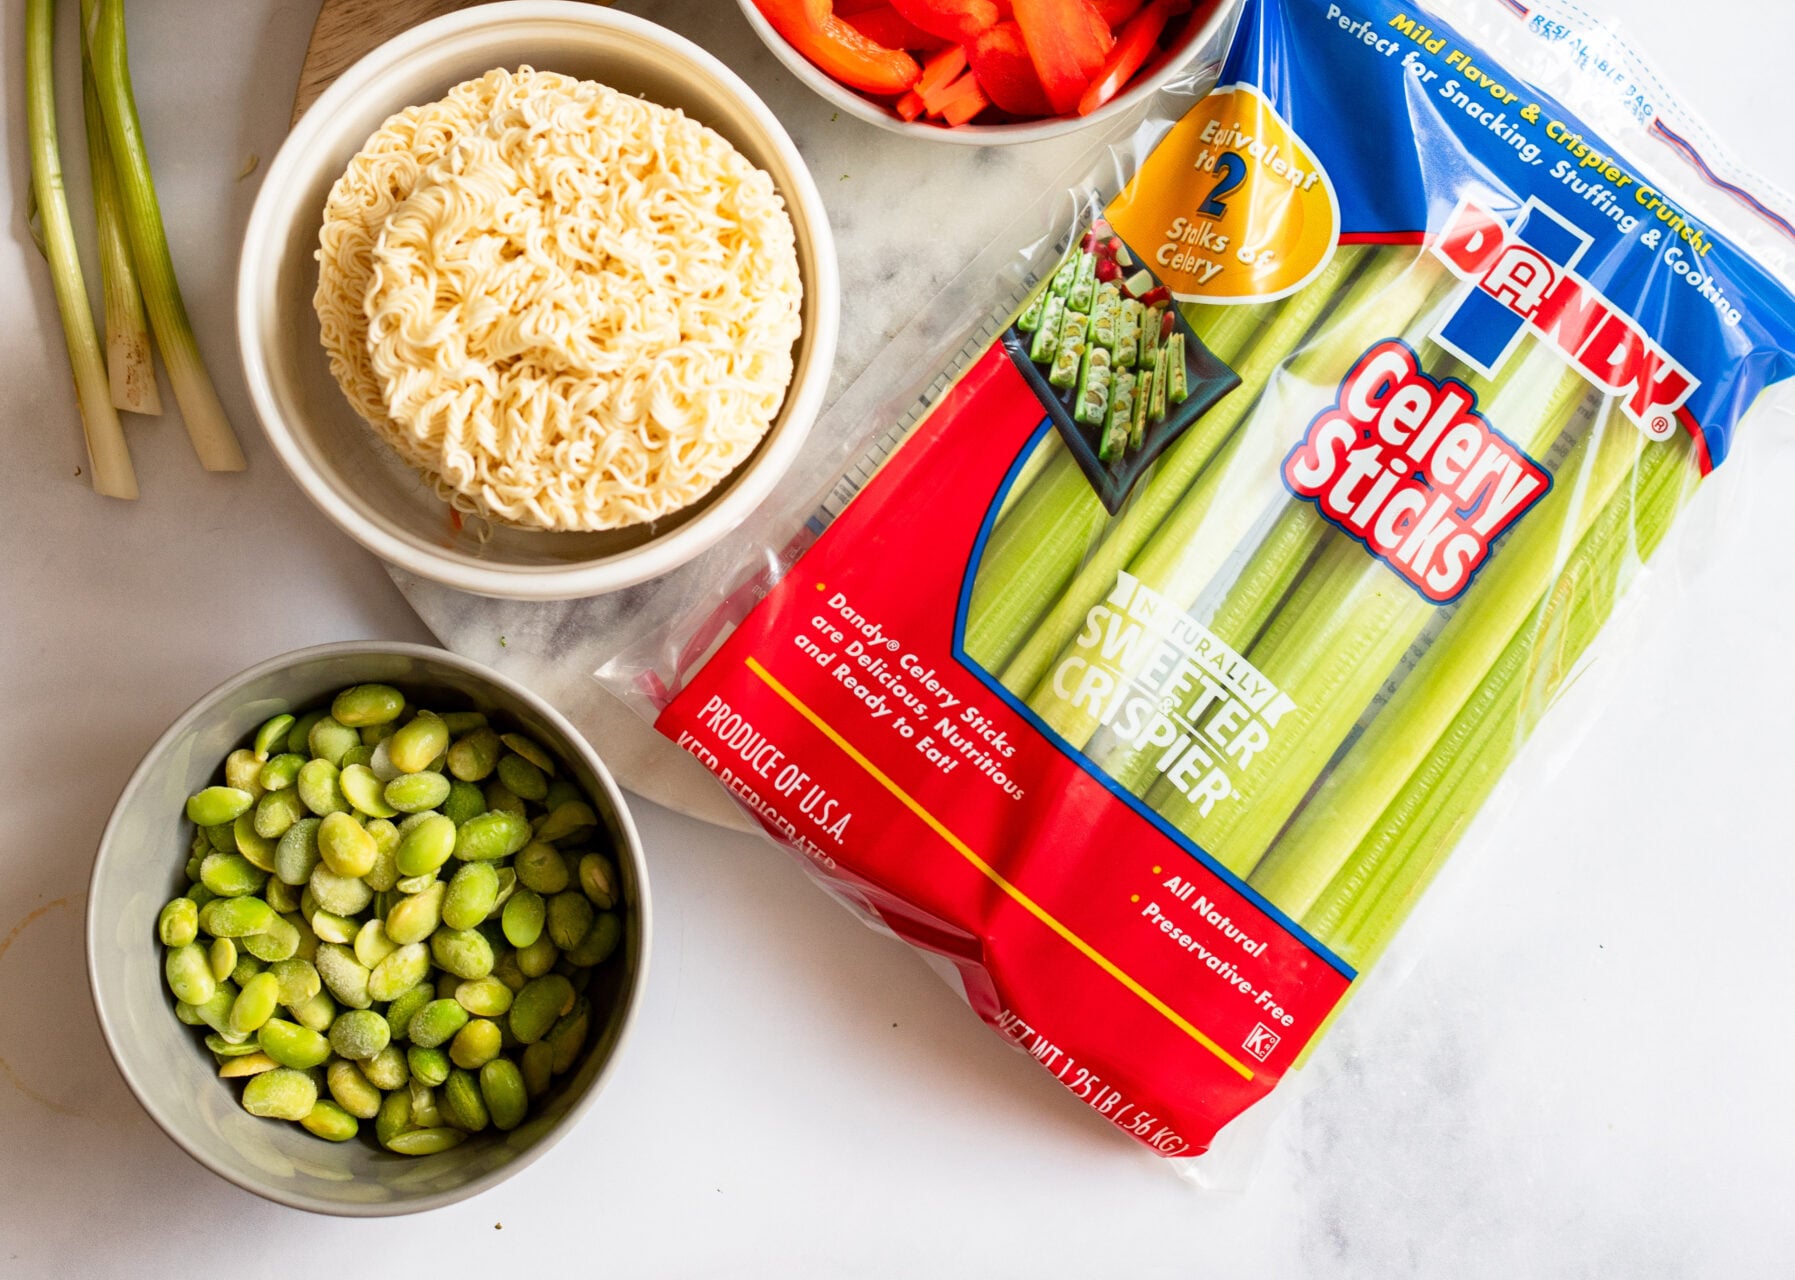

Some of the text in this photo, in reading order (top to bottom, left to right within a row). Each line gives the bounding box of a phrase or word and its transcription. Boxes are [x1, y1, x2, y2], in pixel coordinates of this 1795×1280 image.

[1194, 149, 1247, 218] to 2
[1199, 119, 1319, 193] Equivalent
[1326, 3, 1400, 58] Perfect
[1400, 50, 1438, 84] for
[1438, 79, 1544, 166] Snacking,
[1549, 159, 1640, 235] Stuffing
[1640, 228, 1662, 251] &
[1663, 246, 1743, 327] Cooking
[1388, 13, 1448, 55] Mild
[1445, 49, 1519, 106] Flavor
[1519, 102, 1542, 126] &
[1545, 120, 1633, 189] Crispier
[1635, 185, 1713, 258] Crunch!
[1155, 242, 1224, 286] Celery
[1165, 216, 1276, 271] Stalks of
[1292, 418, 1481, 593] Sticks
[1347, 350, 1541, 537] Celery
[793, 633, 960, 775] and Ready to Eat!
[811, 615, 1025, 802] are Delicious, Nutritious
[900, 653, 961, 709] Celery
[959, 706, 1016, 758] Sticks
[1076, 604, 1270, 772] SWEETER
[1138, 597, 1268, 699] NTURALLY
[1157, 696, 1175, 716] &
[696, 694, 853, 845] PRODUCE OF U.S.A.
[1141, 901, 1295, 1028] Preservative-Free
[1162, 875, 1269, 959] All Natural
[994, 1008, 1036, 1044] NET
[1028, 1034, 1064, 1068] WT
[1088, 1084, 1122, 1114] LB
[1111, 1102, 1158, 1137] (.56
[1146, 1125, 1190, 1158] KG)
